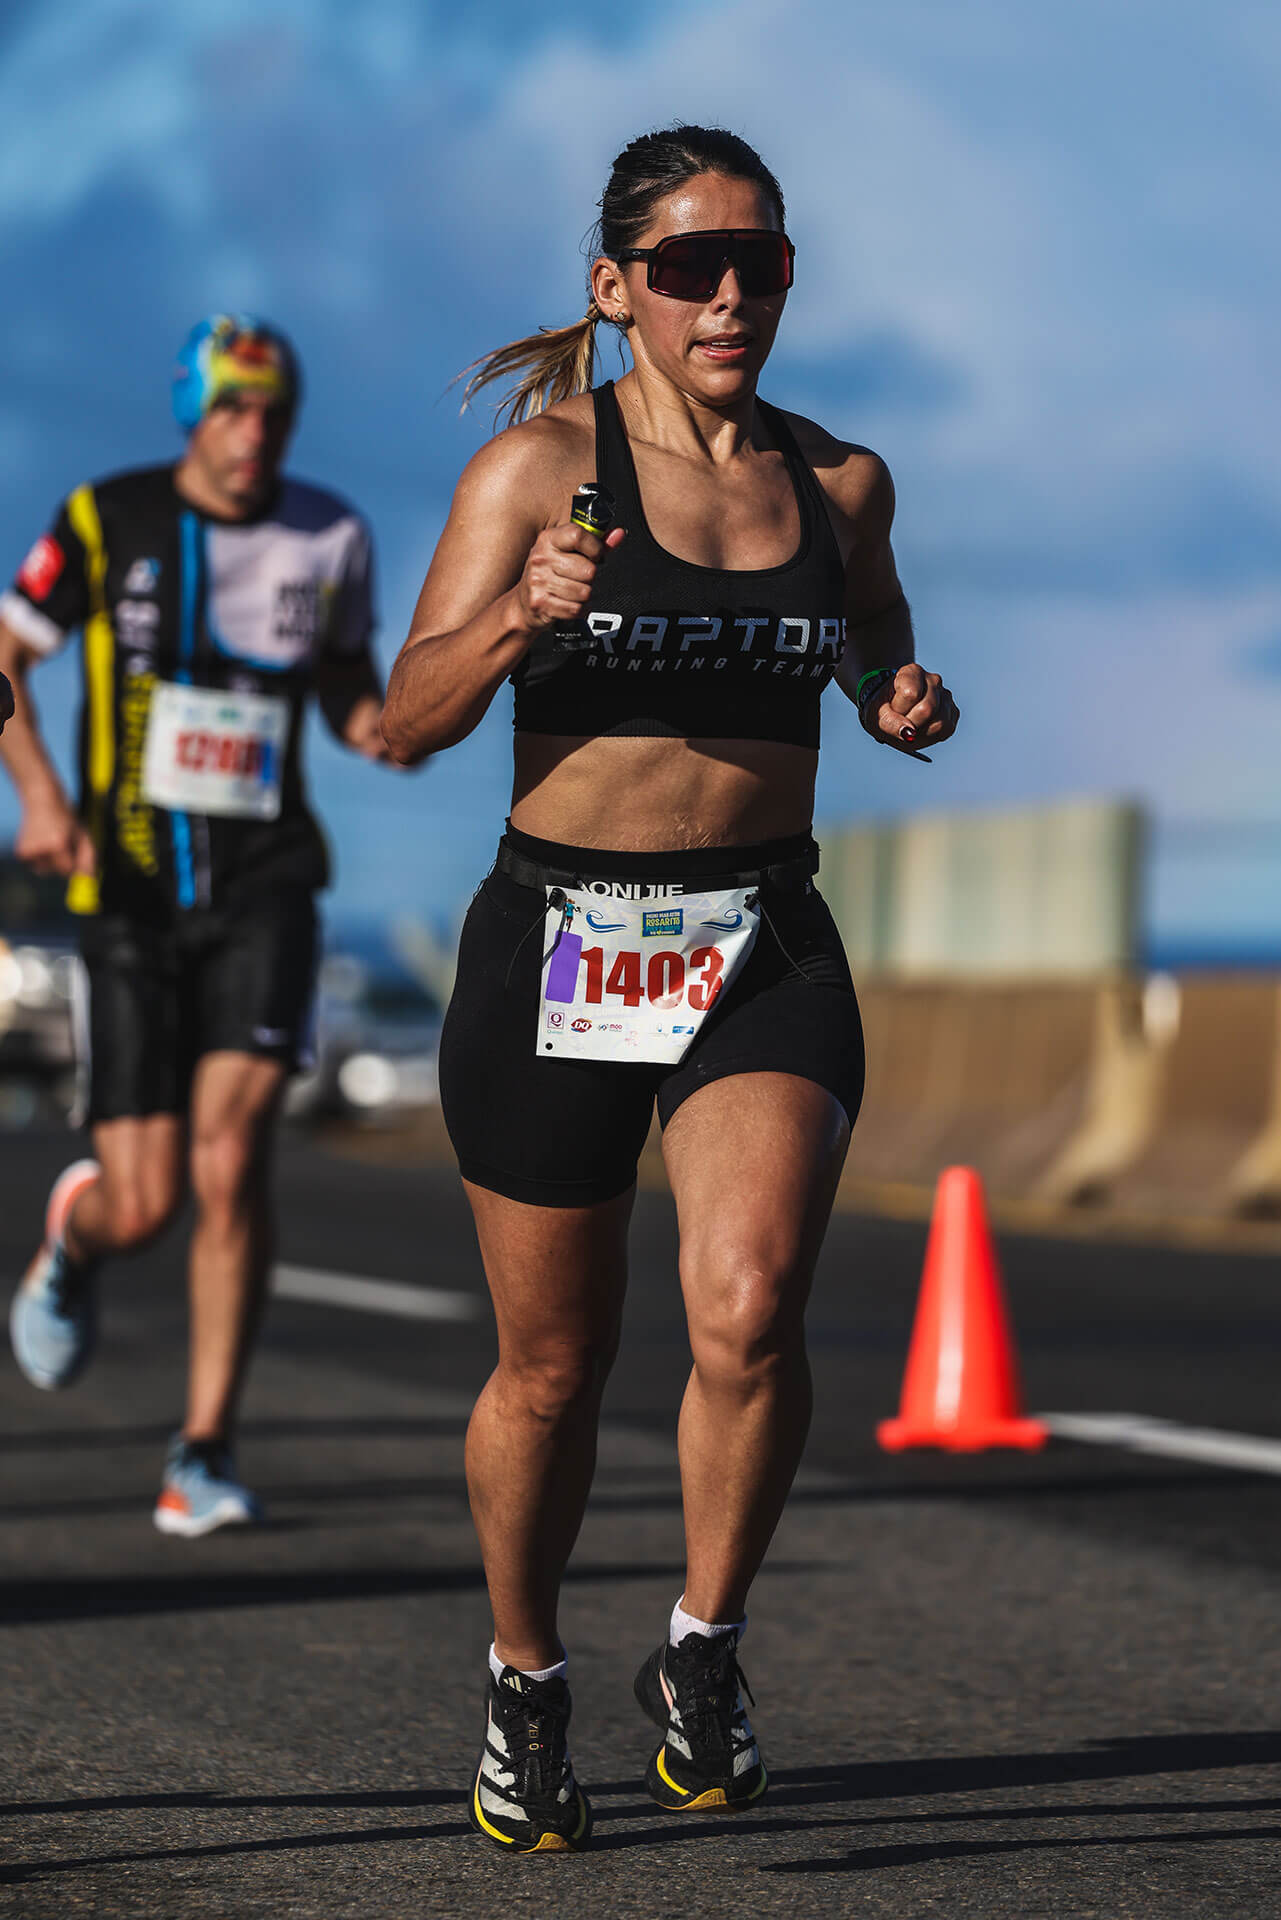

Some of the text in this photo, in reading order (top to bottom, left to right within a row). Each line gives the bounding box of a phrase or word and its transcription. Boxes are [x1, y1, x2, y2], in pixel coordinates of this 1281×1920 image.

[586, 655, 727, 671] RUNNING
[580, 946, 724, 1011] 1403
[575, 1020, 590, 1030] DQ
